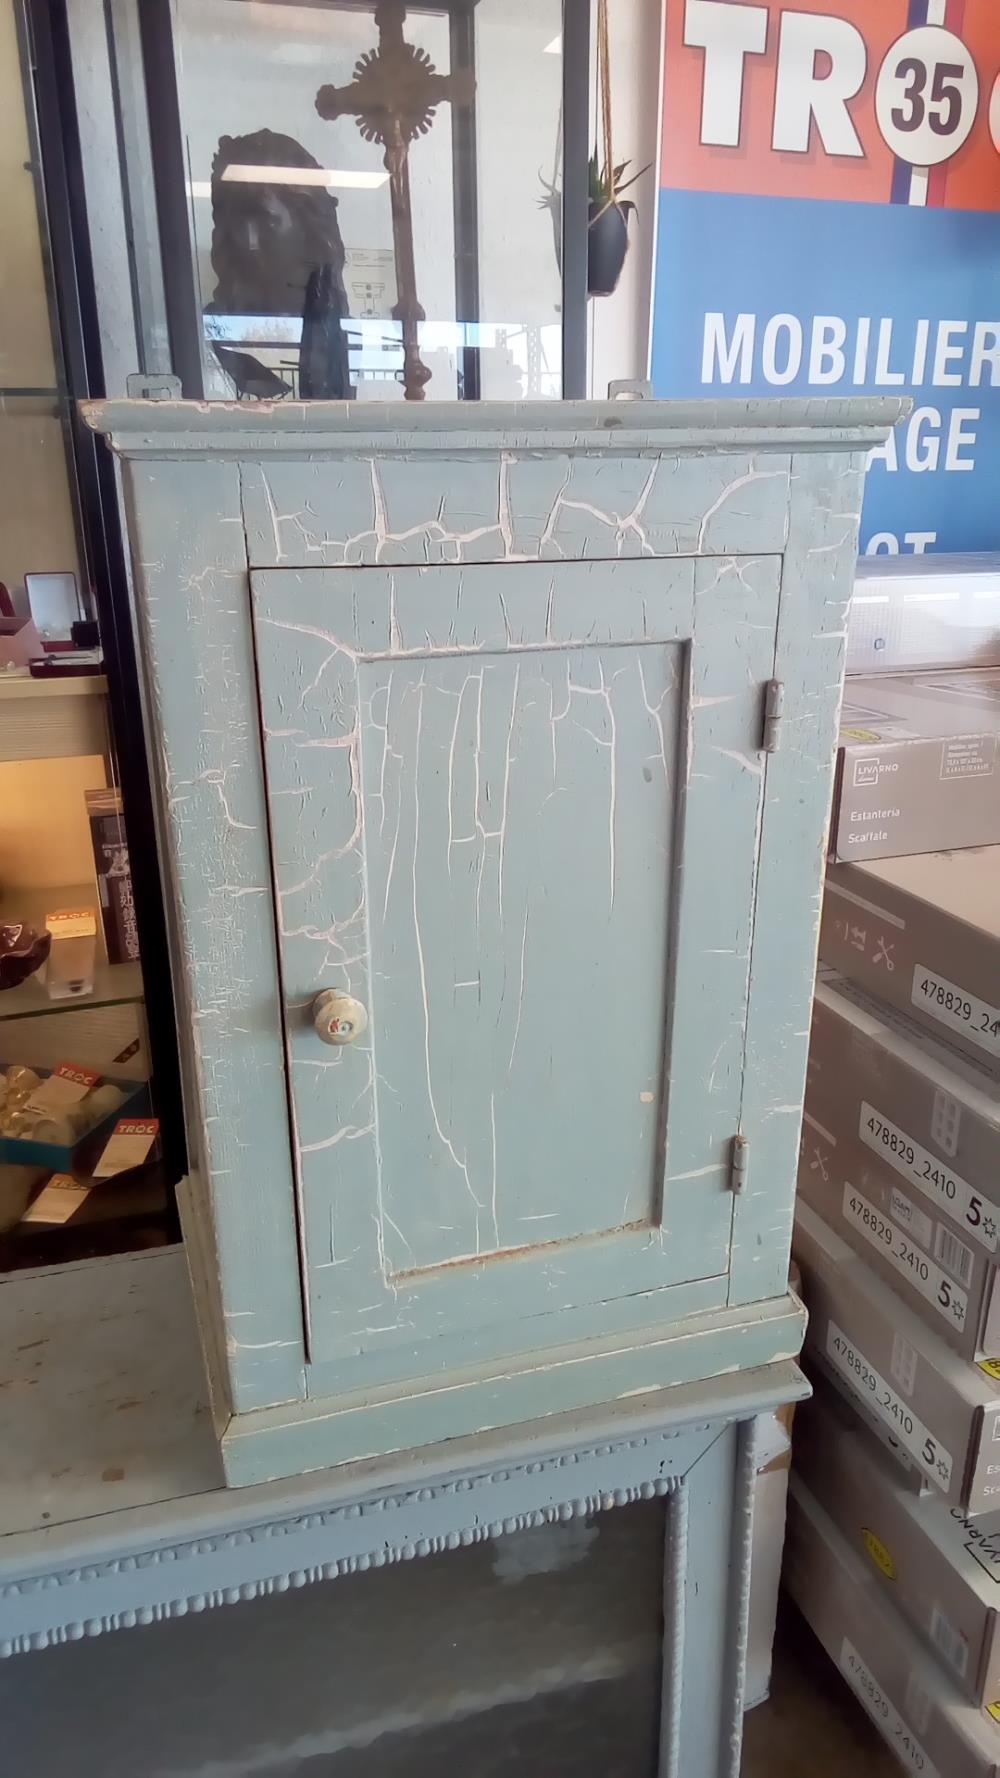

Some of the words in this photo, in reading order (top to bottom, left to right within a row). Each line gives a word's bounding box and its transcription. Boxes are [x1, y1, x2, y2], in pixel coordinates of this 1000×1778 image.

[890, 57, 964, 136] 35
[848, 830, 888, 844] Scaffale
[850, 808, 900, 821] Estanteria
[920, 979, 1000, 1037] 478829_24
[60, 1067, 93, 1085] TROC
[119, 1125, 155, 1133] TROC
[867, 1118, 956, 1199] 478829_2410
[849, 1198, 928, 1280] 478829_2410
[833, 1337, 913, 1434] 478829_2410
